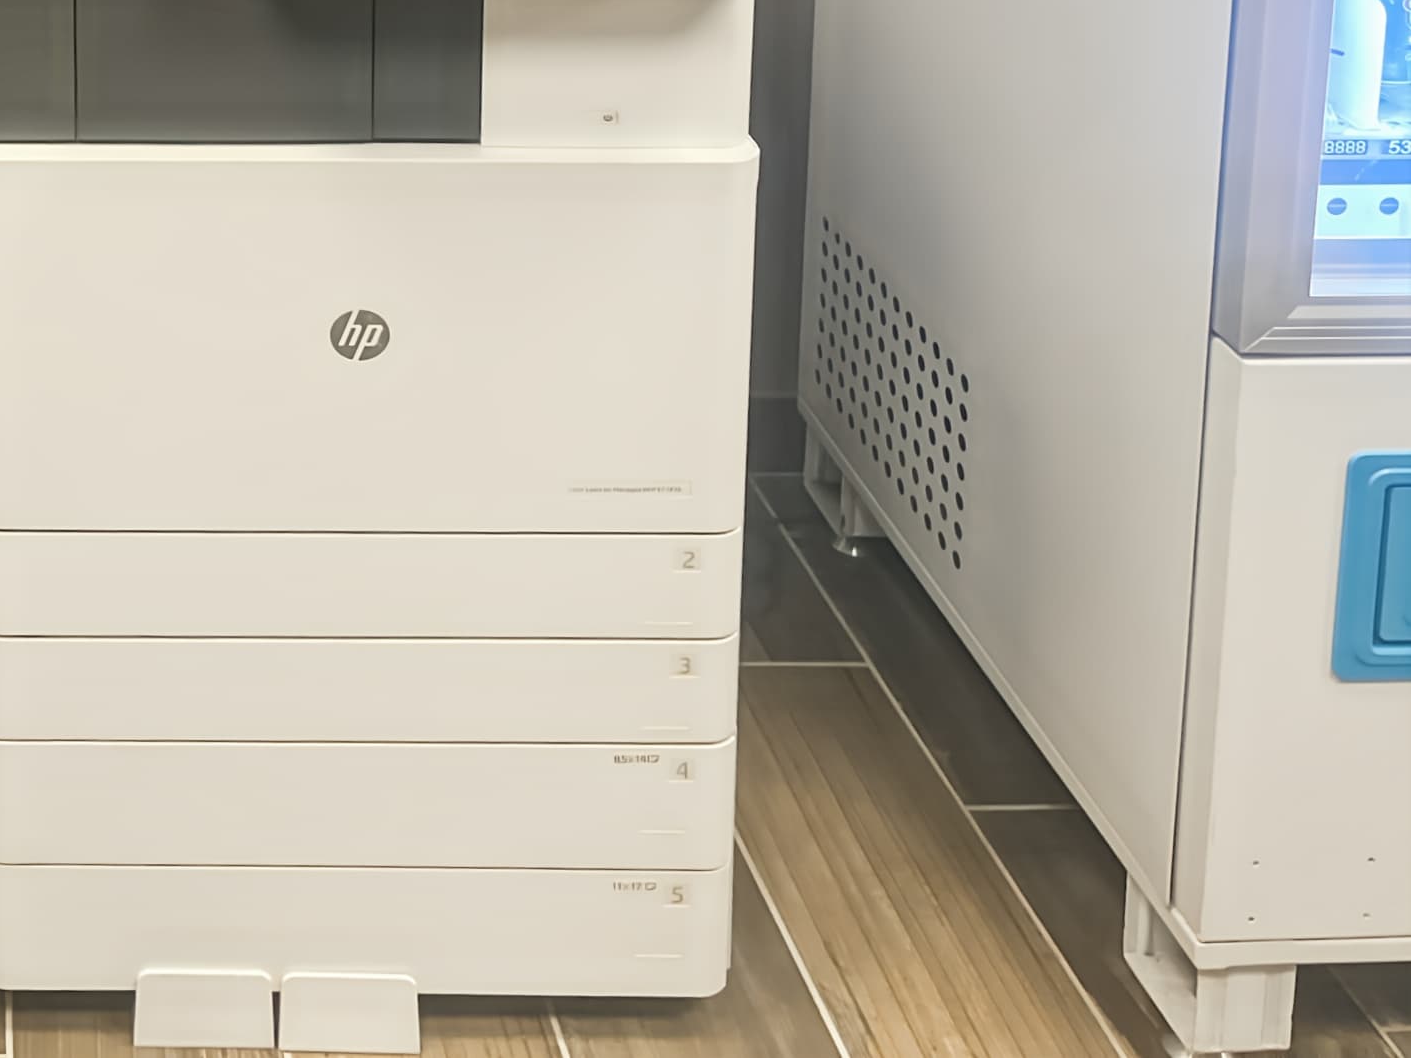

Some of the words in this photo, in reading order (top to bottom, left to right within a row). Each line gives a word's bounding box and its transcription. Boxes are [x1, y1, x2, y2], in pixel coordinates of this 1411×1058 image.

[335, 309, 386, 361] hp
[682, 551, 695, 569] 2
[679, 657, 690, 675] 3
[676, 761, 688, 779] 4
[671, 885, 684, 904] 5
